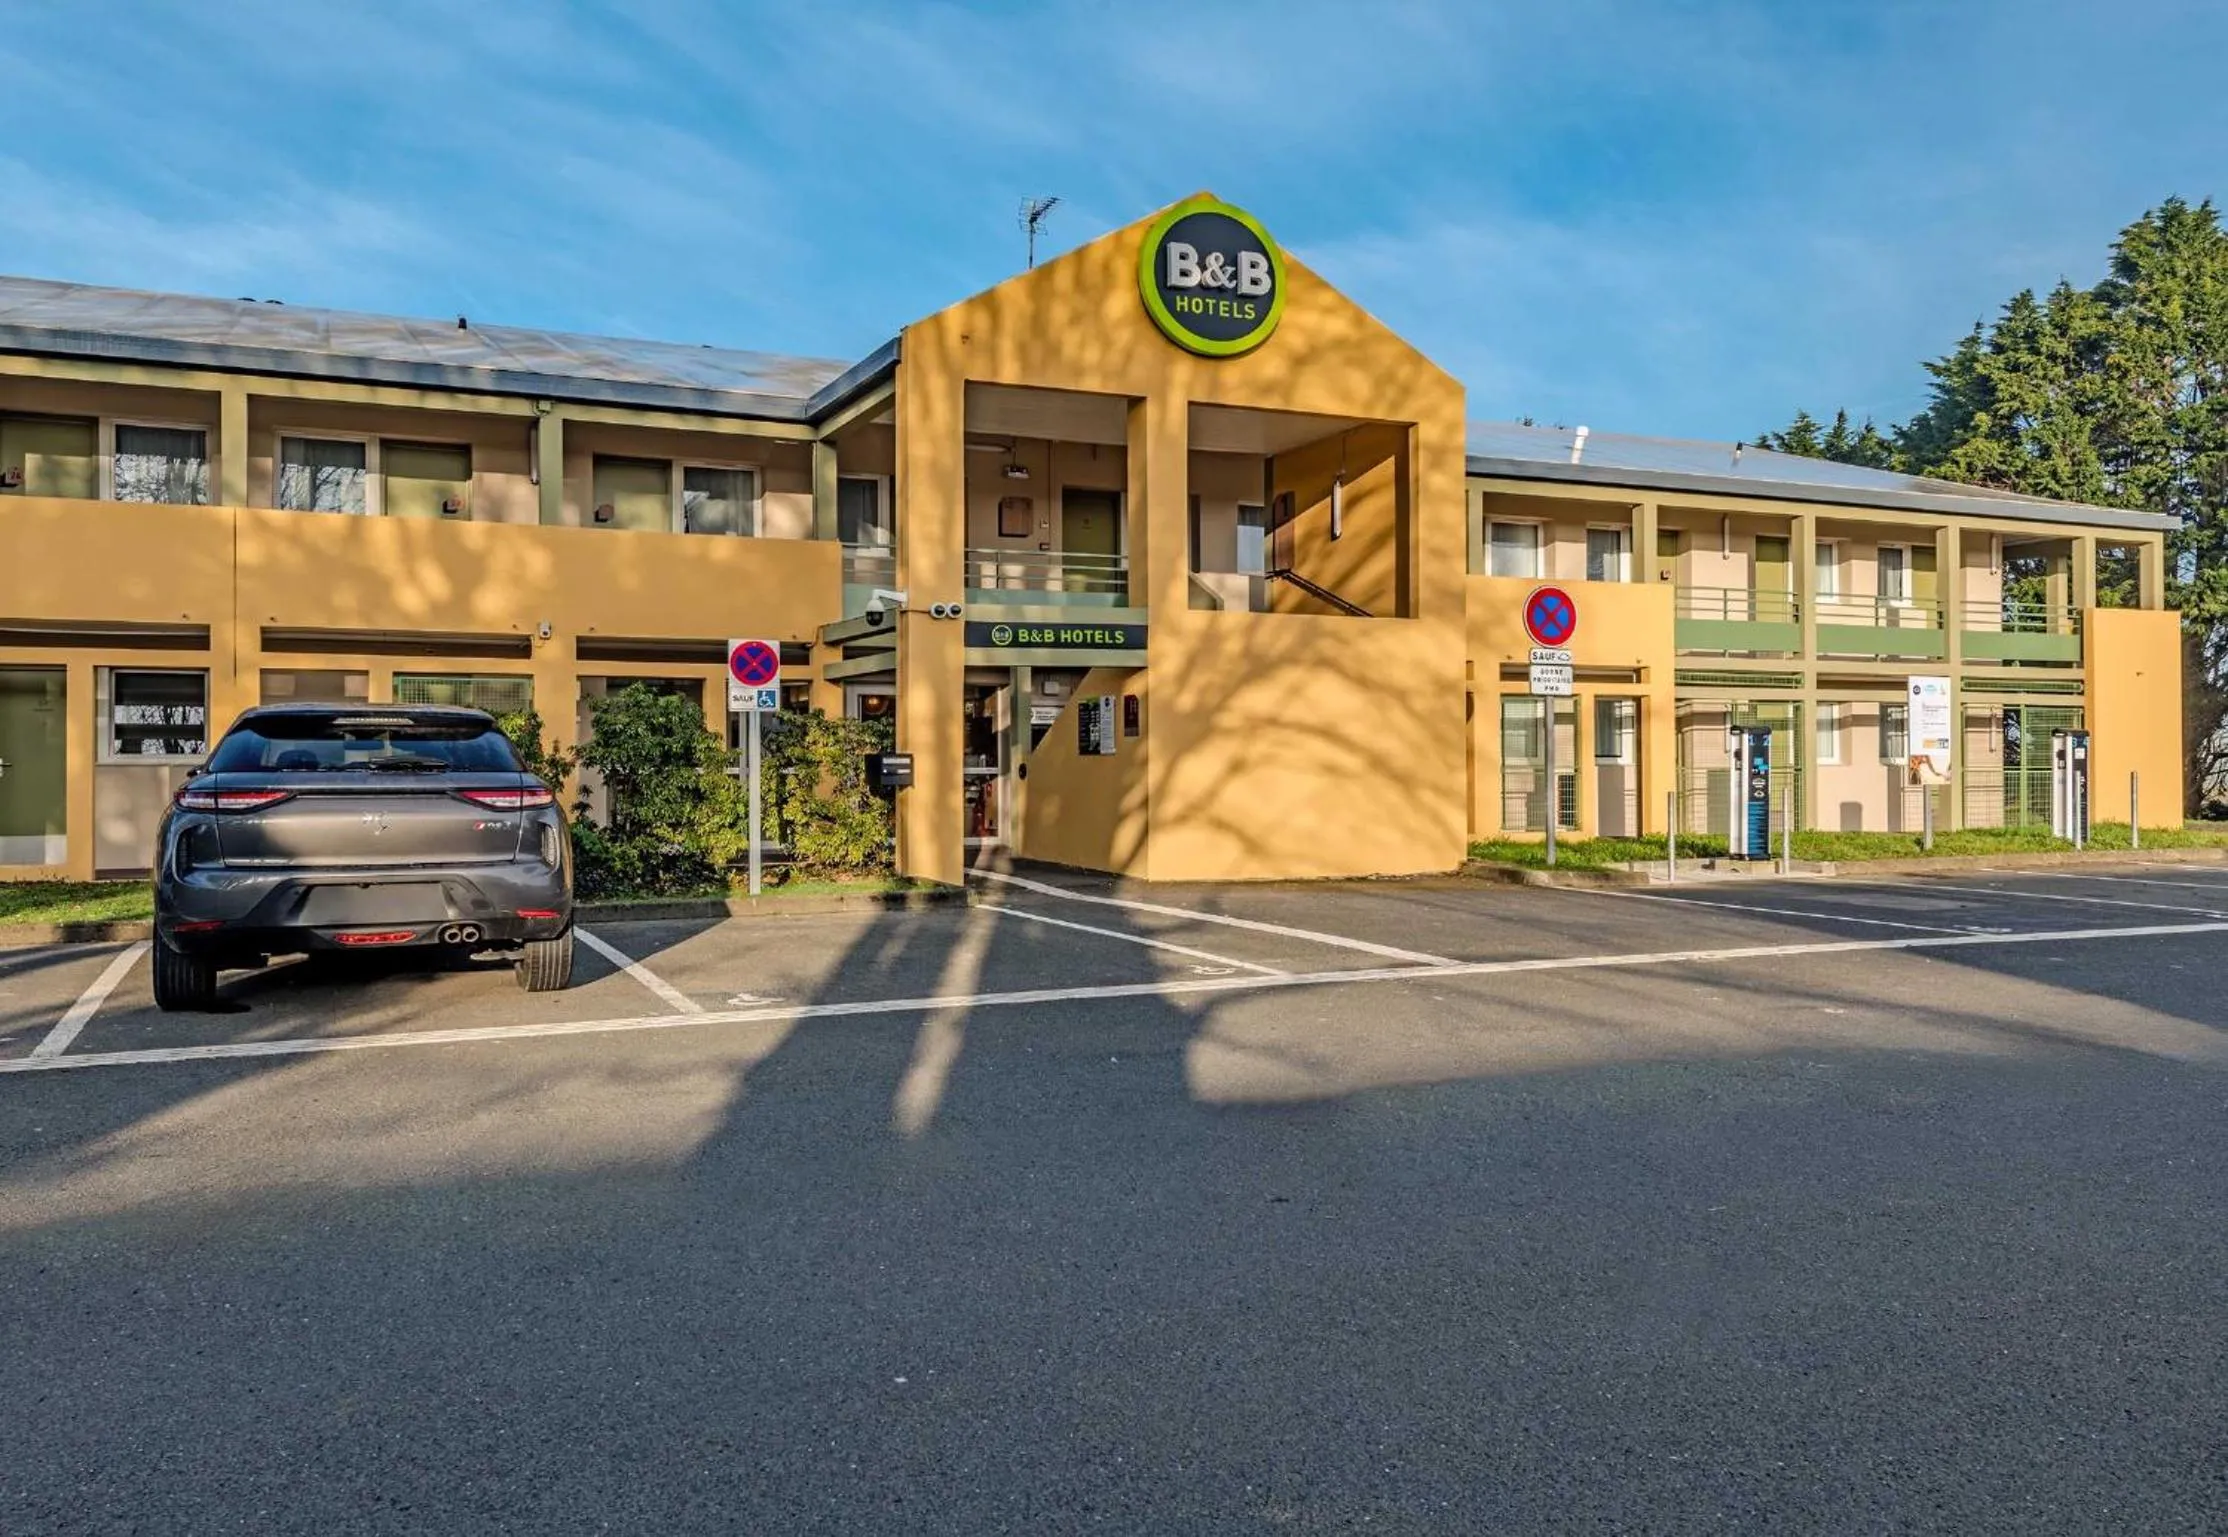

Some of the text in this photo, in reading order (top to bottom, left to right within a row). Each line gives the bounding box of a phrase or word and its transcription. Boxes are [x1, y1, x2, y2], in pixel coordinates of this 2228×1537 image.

[1167, 241, 1272, 296] B&B
[1176, 295, 1256, 320] HOTELS
[1018, 629, 1125, 644] B&B HOTELS
[1532, 652, 1556, 661] SAUF
